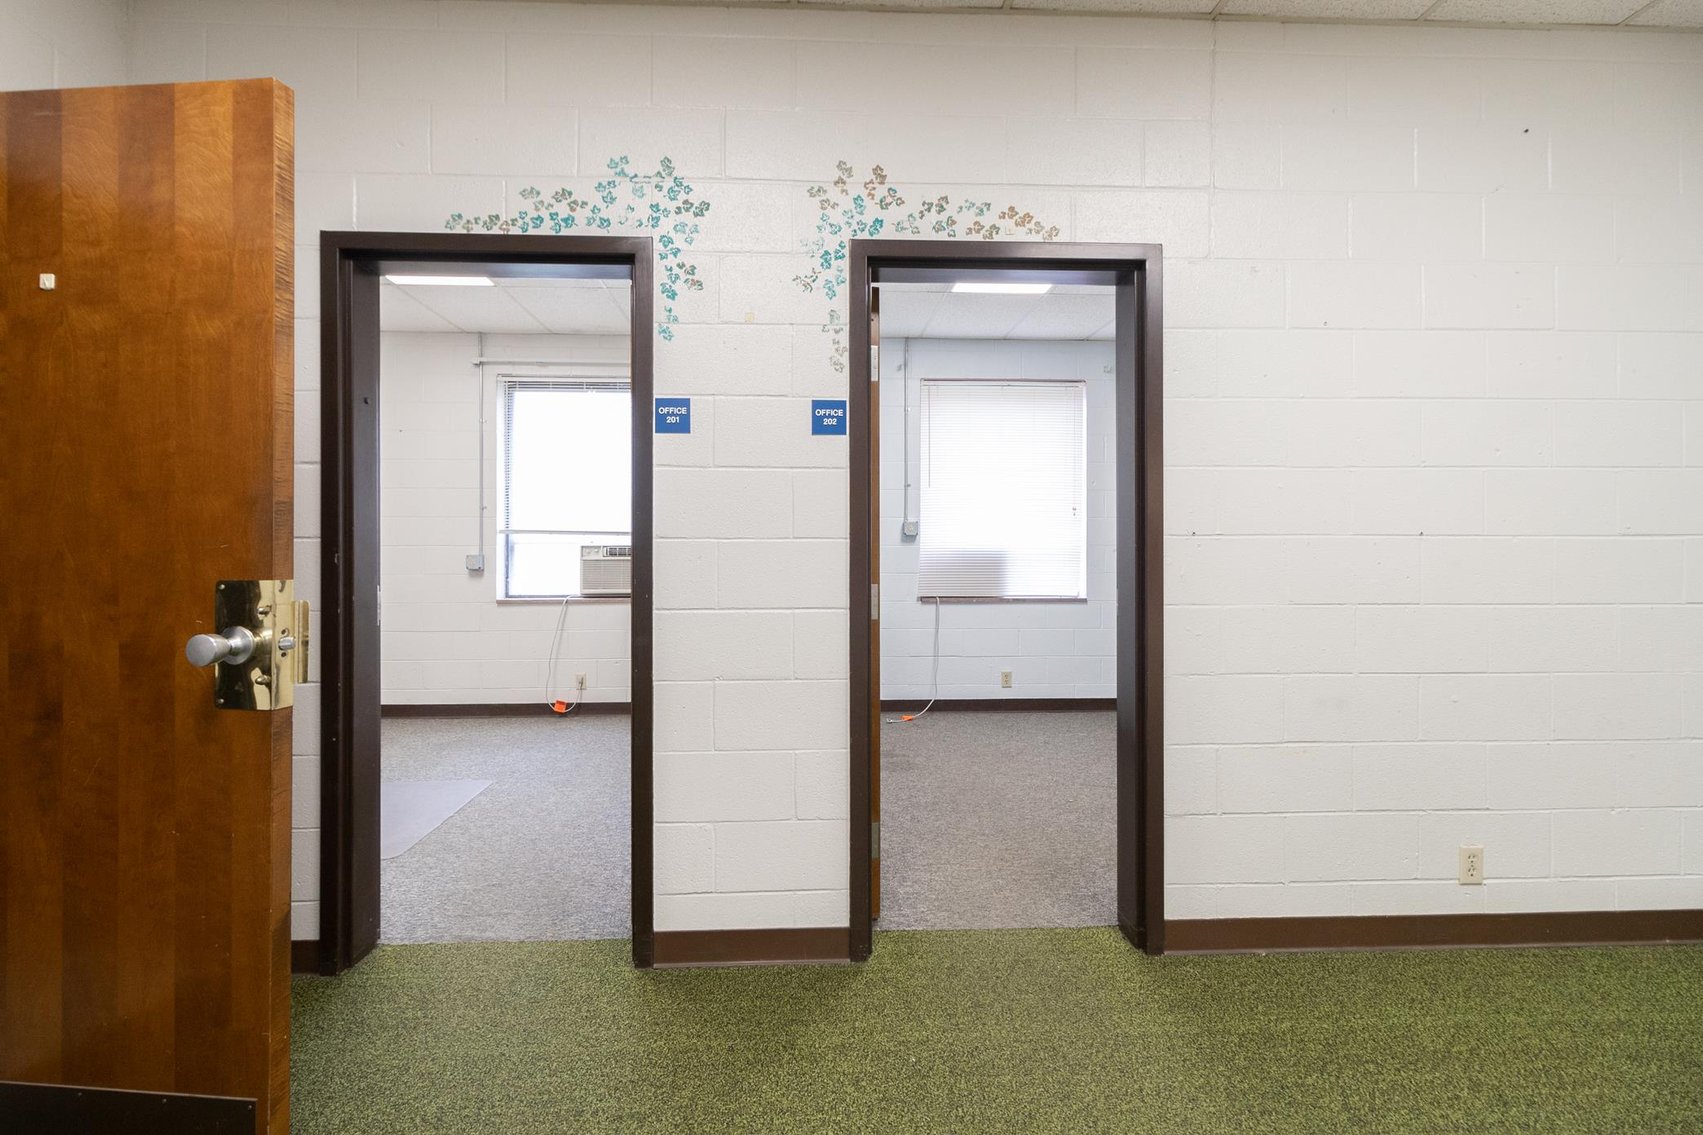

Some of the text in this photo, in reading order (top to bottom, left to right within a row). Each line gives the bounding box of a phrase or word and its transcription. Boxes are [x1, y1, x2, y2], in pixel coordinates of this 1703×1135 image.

[658, 406, 687, 414] OFFICE
[815, 408, 843, 416] OFFICE
[666, 416, 680, 424] 201
